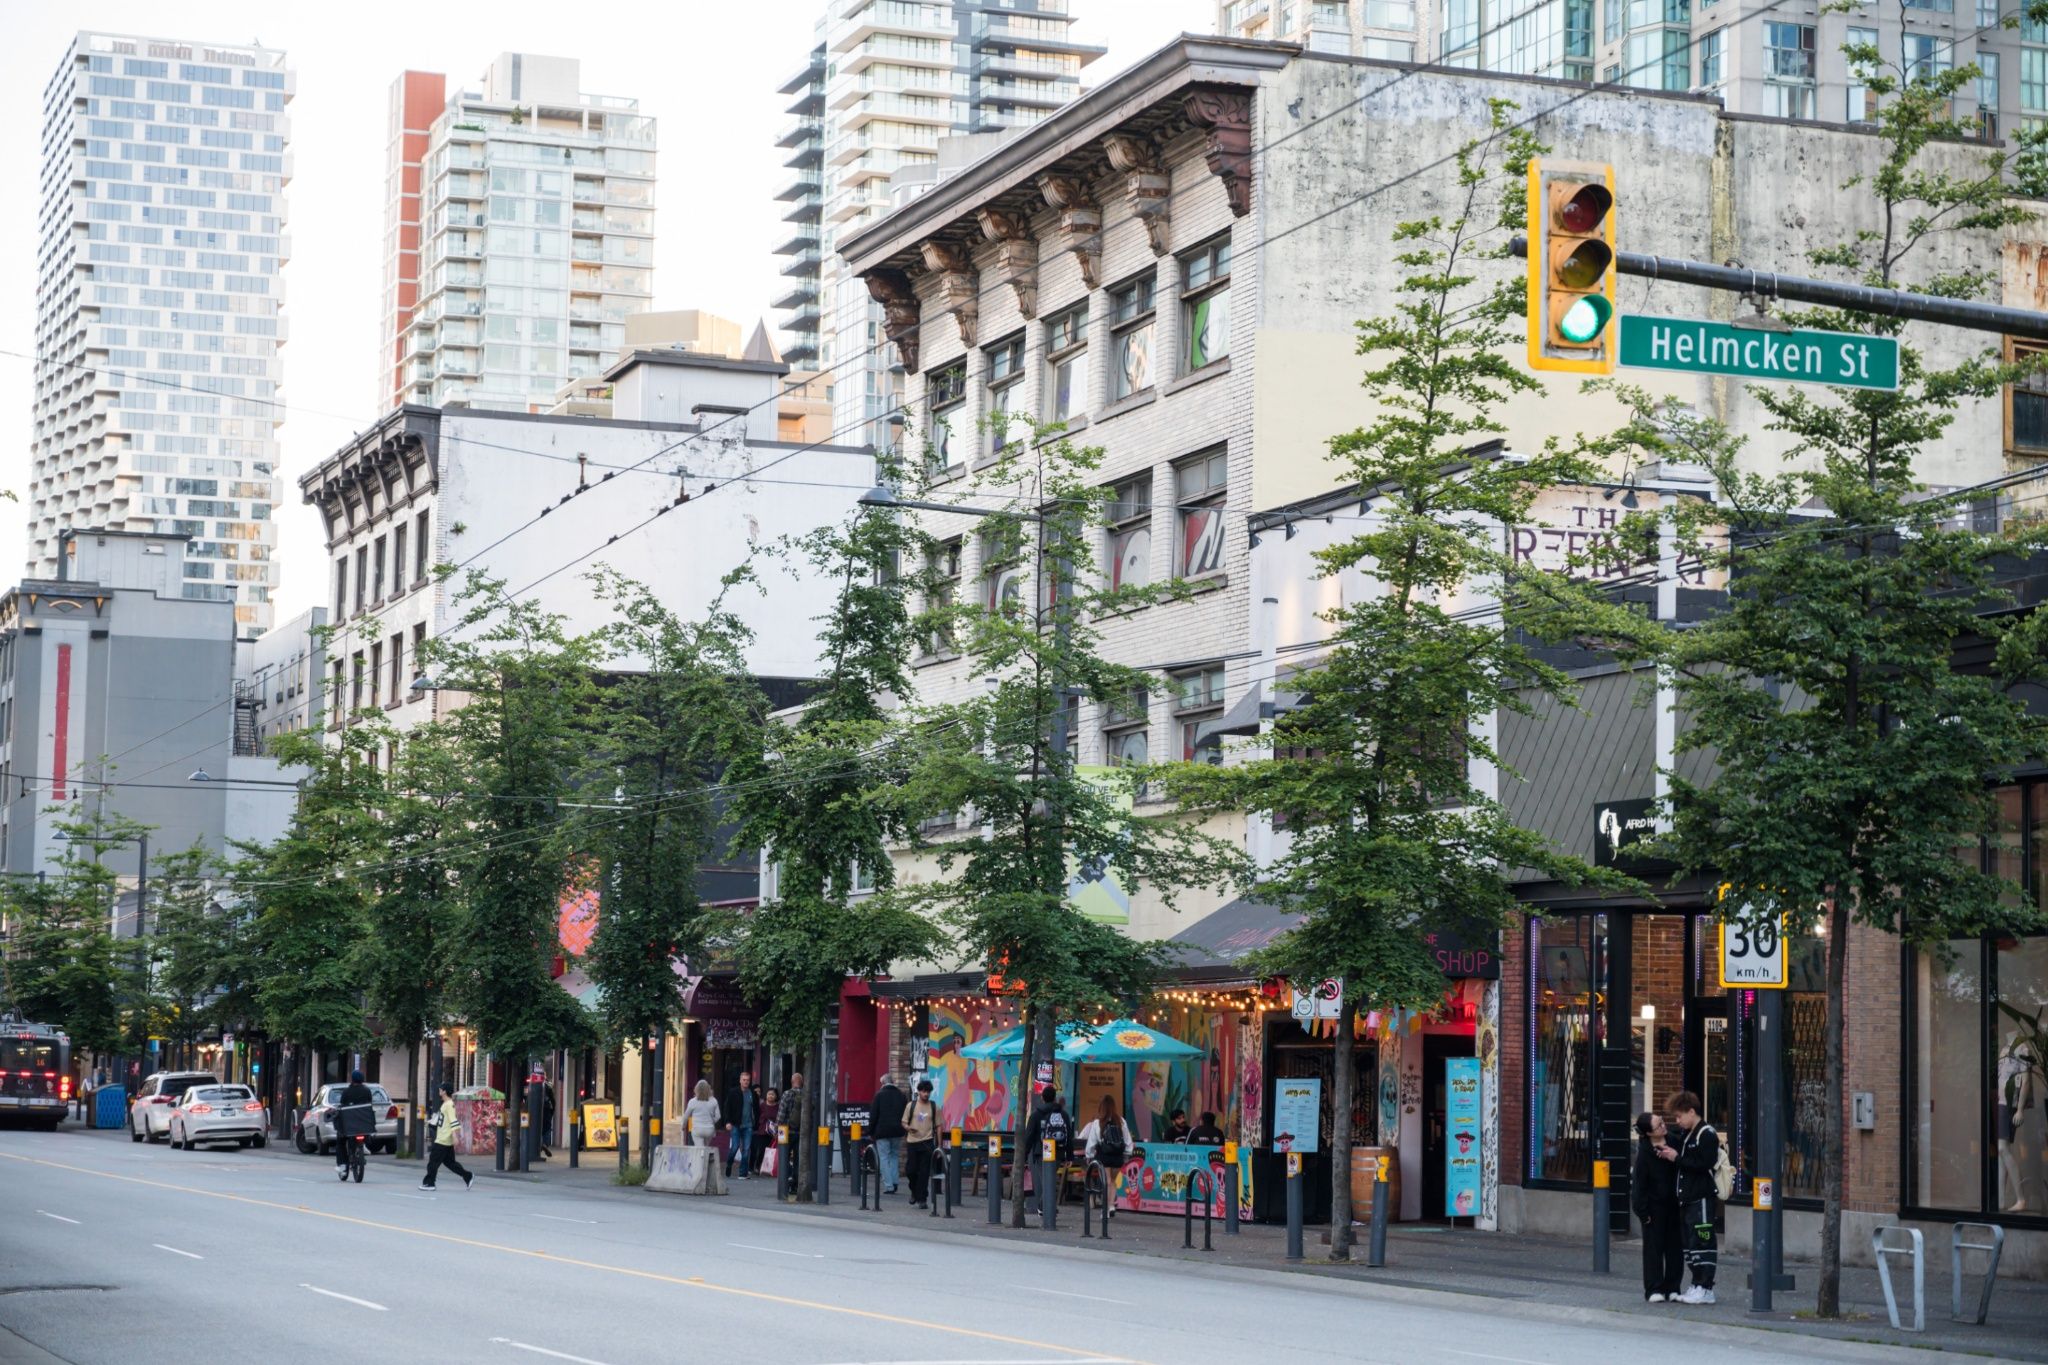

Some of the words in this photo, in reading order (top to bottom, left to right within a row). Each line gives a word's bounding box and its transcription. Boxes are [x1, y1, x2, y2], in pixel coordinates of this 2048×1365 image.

[1651, 326, 1822, 374] Helmcken
[1839, 344, 1869, 379] St
[1572, 506, 1642, 528] TH
[1625, 818, 1647, 830] AFRO
[1728, 915, 1778, 959] 30
[1736, 965, 1770, 979] km/h
[839, 1111, 871, 1120] ESCAPE
